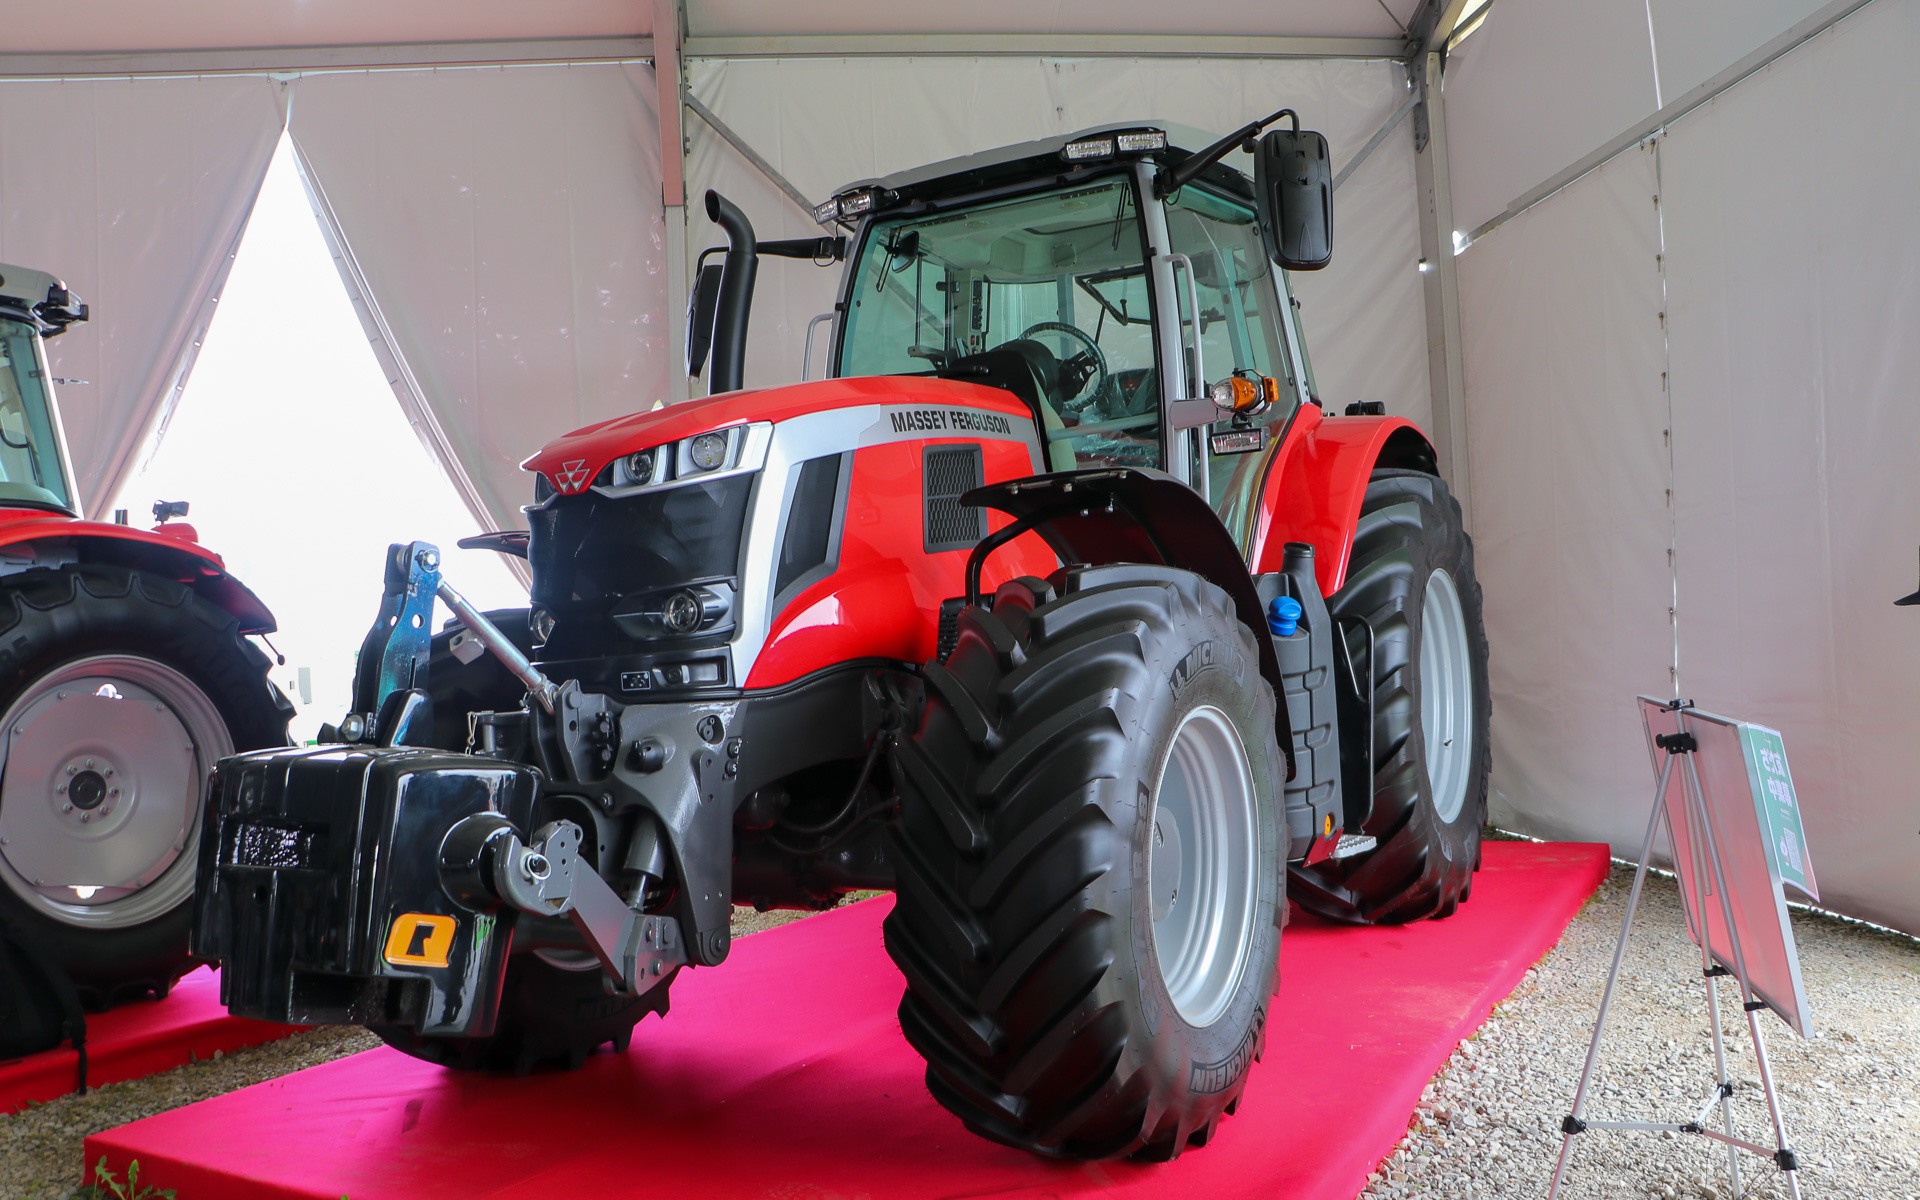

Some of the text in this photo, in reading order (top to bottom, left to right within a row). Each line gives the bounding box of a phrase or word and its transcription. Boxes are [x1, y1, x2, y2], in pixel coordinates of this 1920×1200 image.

[890, 411, 1011, 435] MASSEY FERGUSON
[1190, 1033, 1255, 1092] MICHELIN
